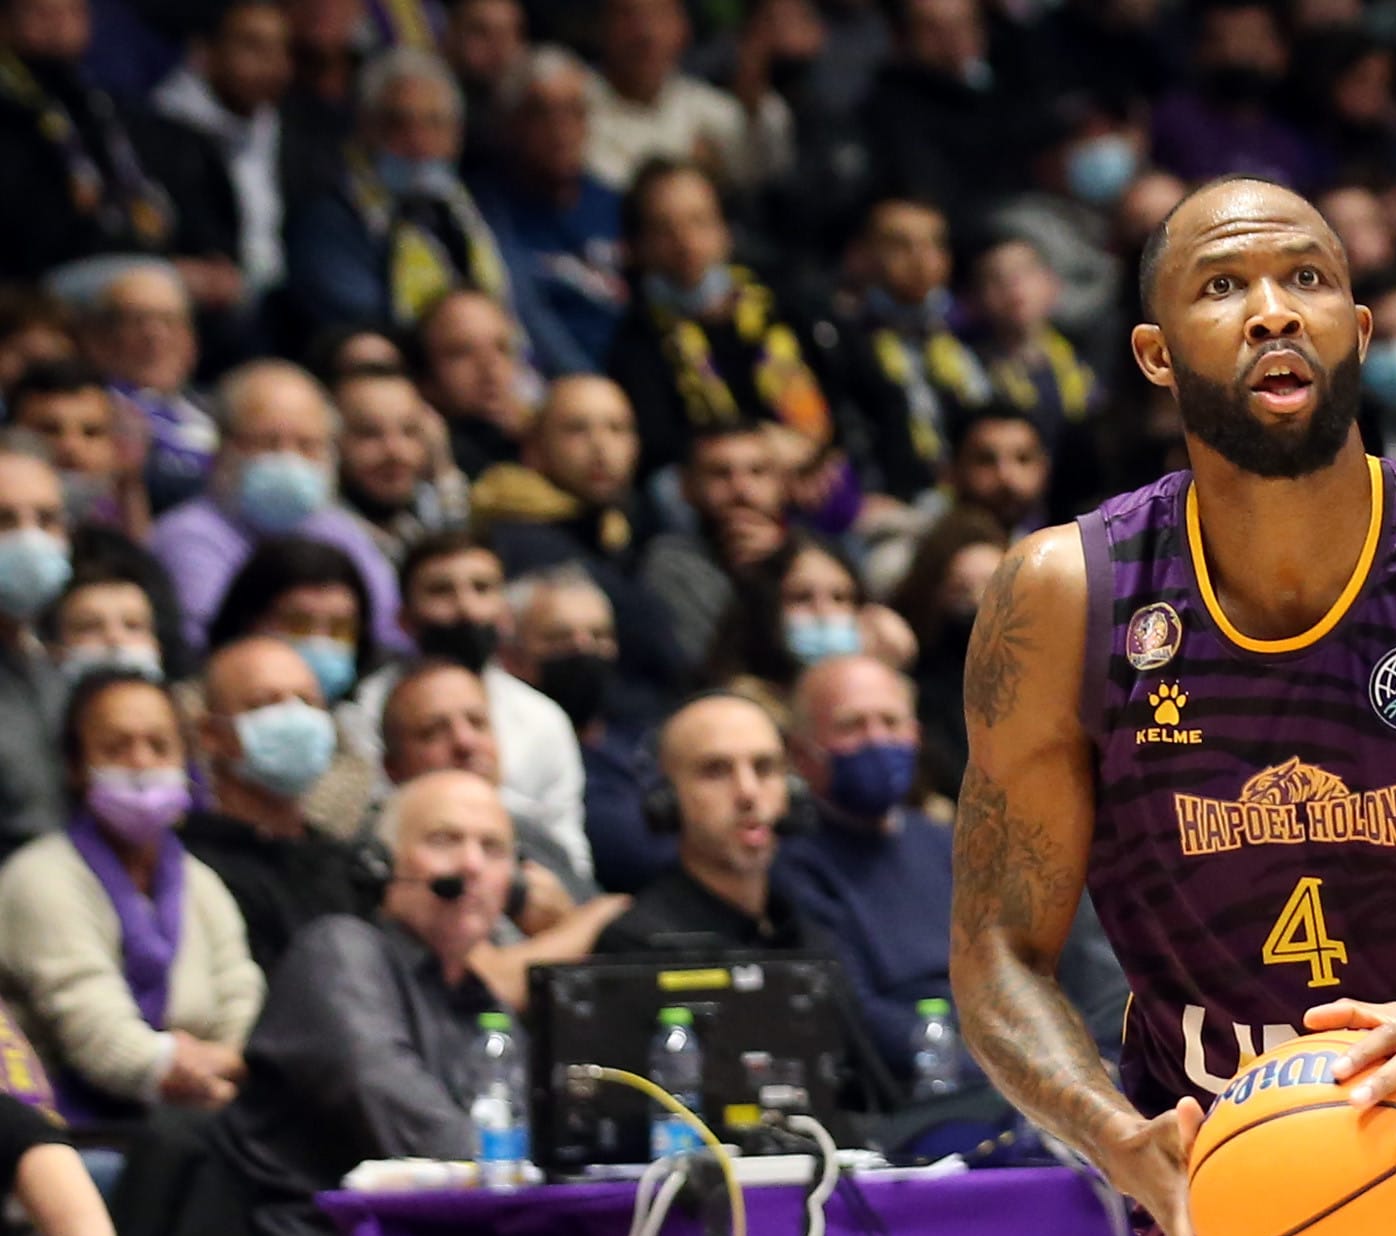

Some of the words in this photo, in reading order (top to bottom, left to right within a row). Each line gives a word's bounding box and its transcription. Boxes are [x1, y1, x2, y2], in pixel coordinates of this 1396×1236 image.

[1135, 727, 1203, 744] KELME
[1174, 793, 1306, 856] HAPOEL
[1262, 876, 1348, 988] 4
